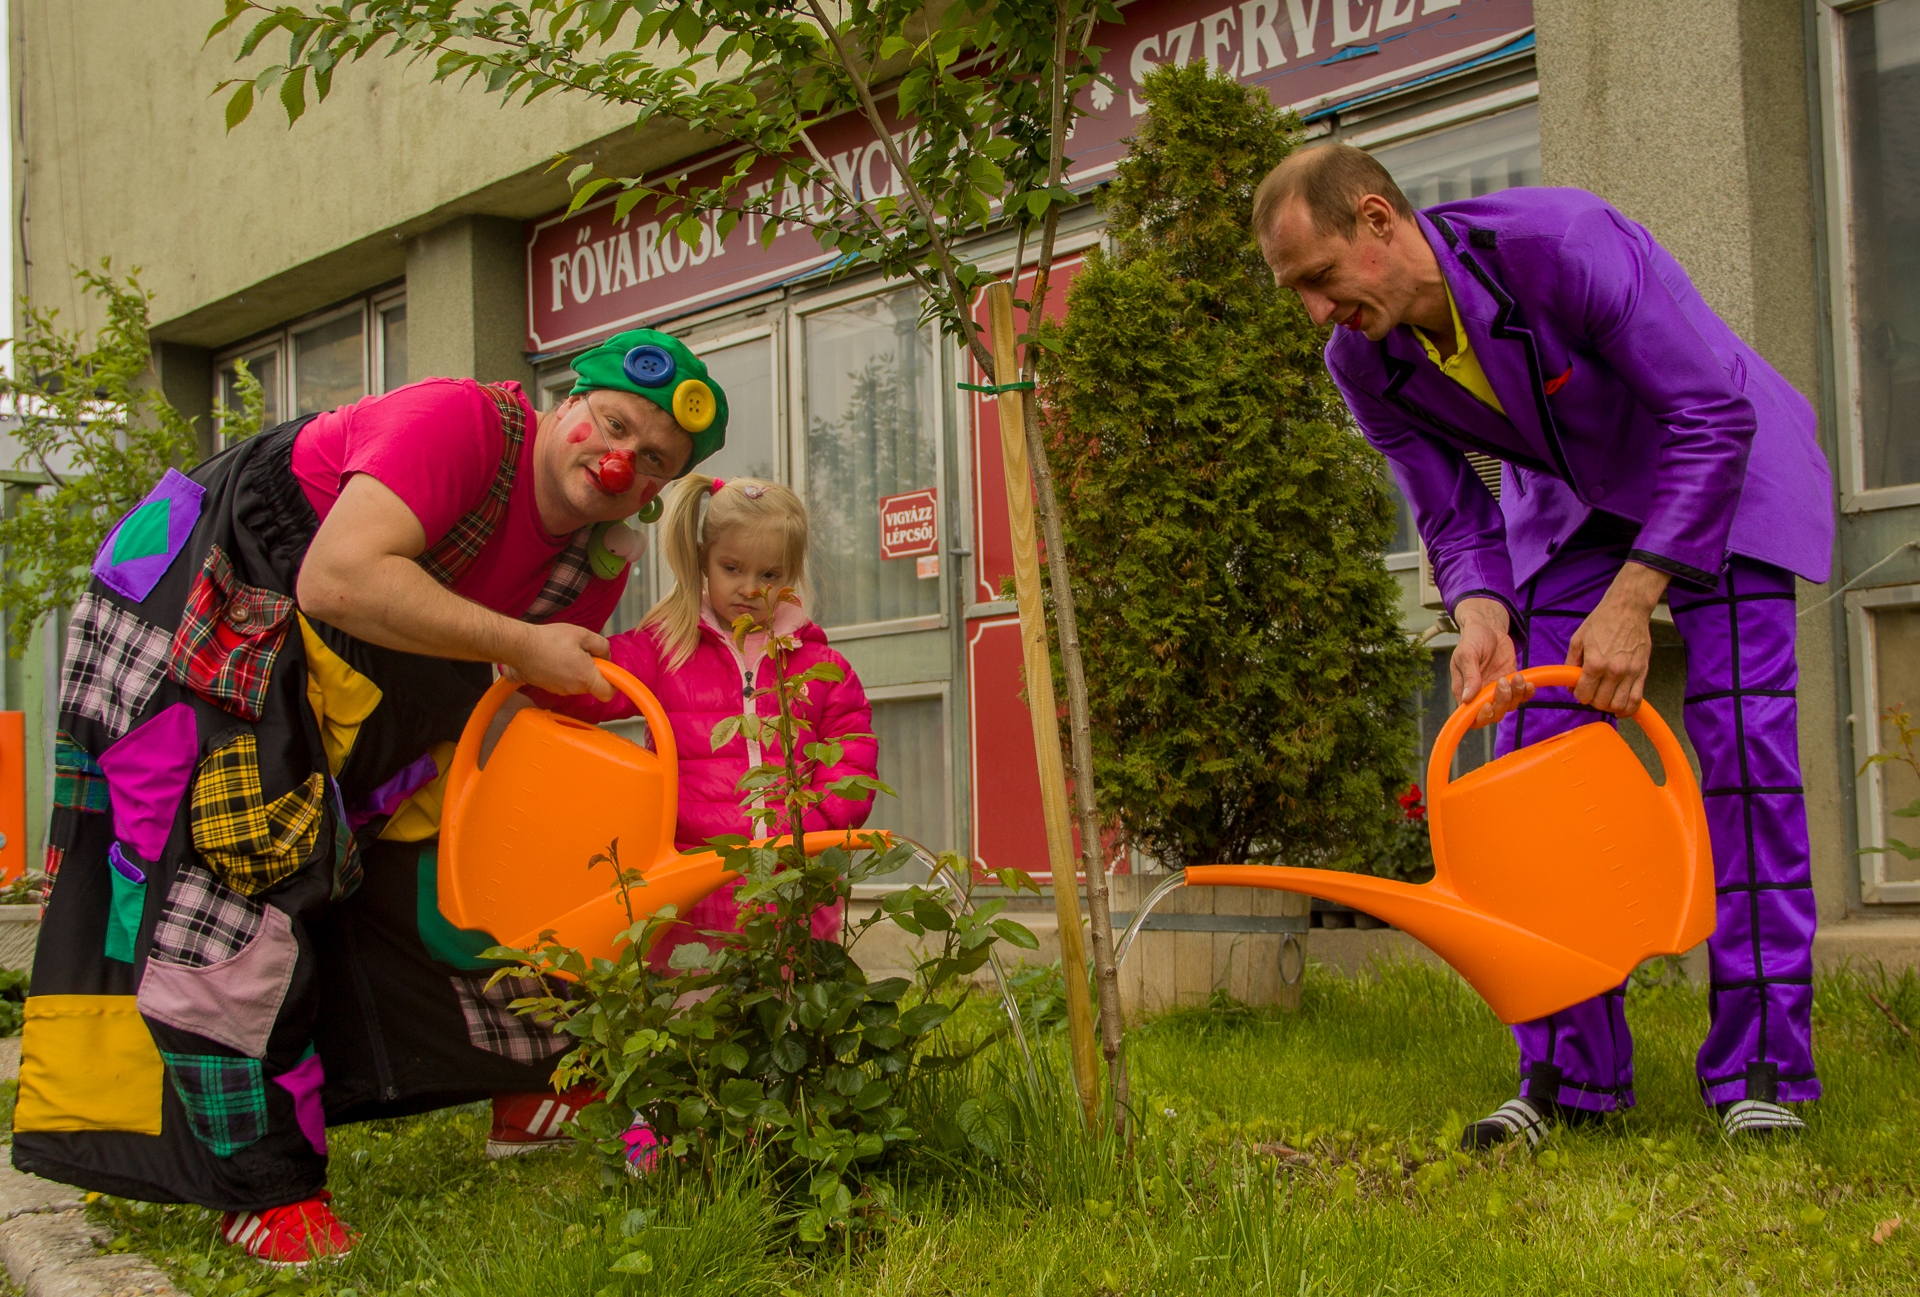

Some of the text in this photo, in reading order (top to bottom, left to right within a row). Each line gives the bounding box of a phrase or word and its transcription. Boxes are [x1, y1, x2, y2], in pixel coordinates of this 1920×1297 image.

[551, 206, 725, 312] FŐVÁROSI
[886, 505, 932, 526] VIGYÁZZ
[886, 522, 932, 546] LÉPCSŐ!
